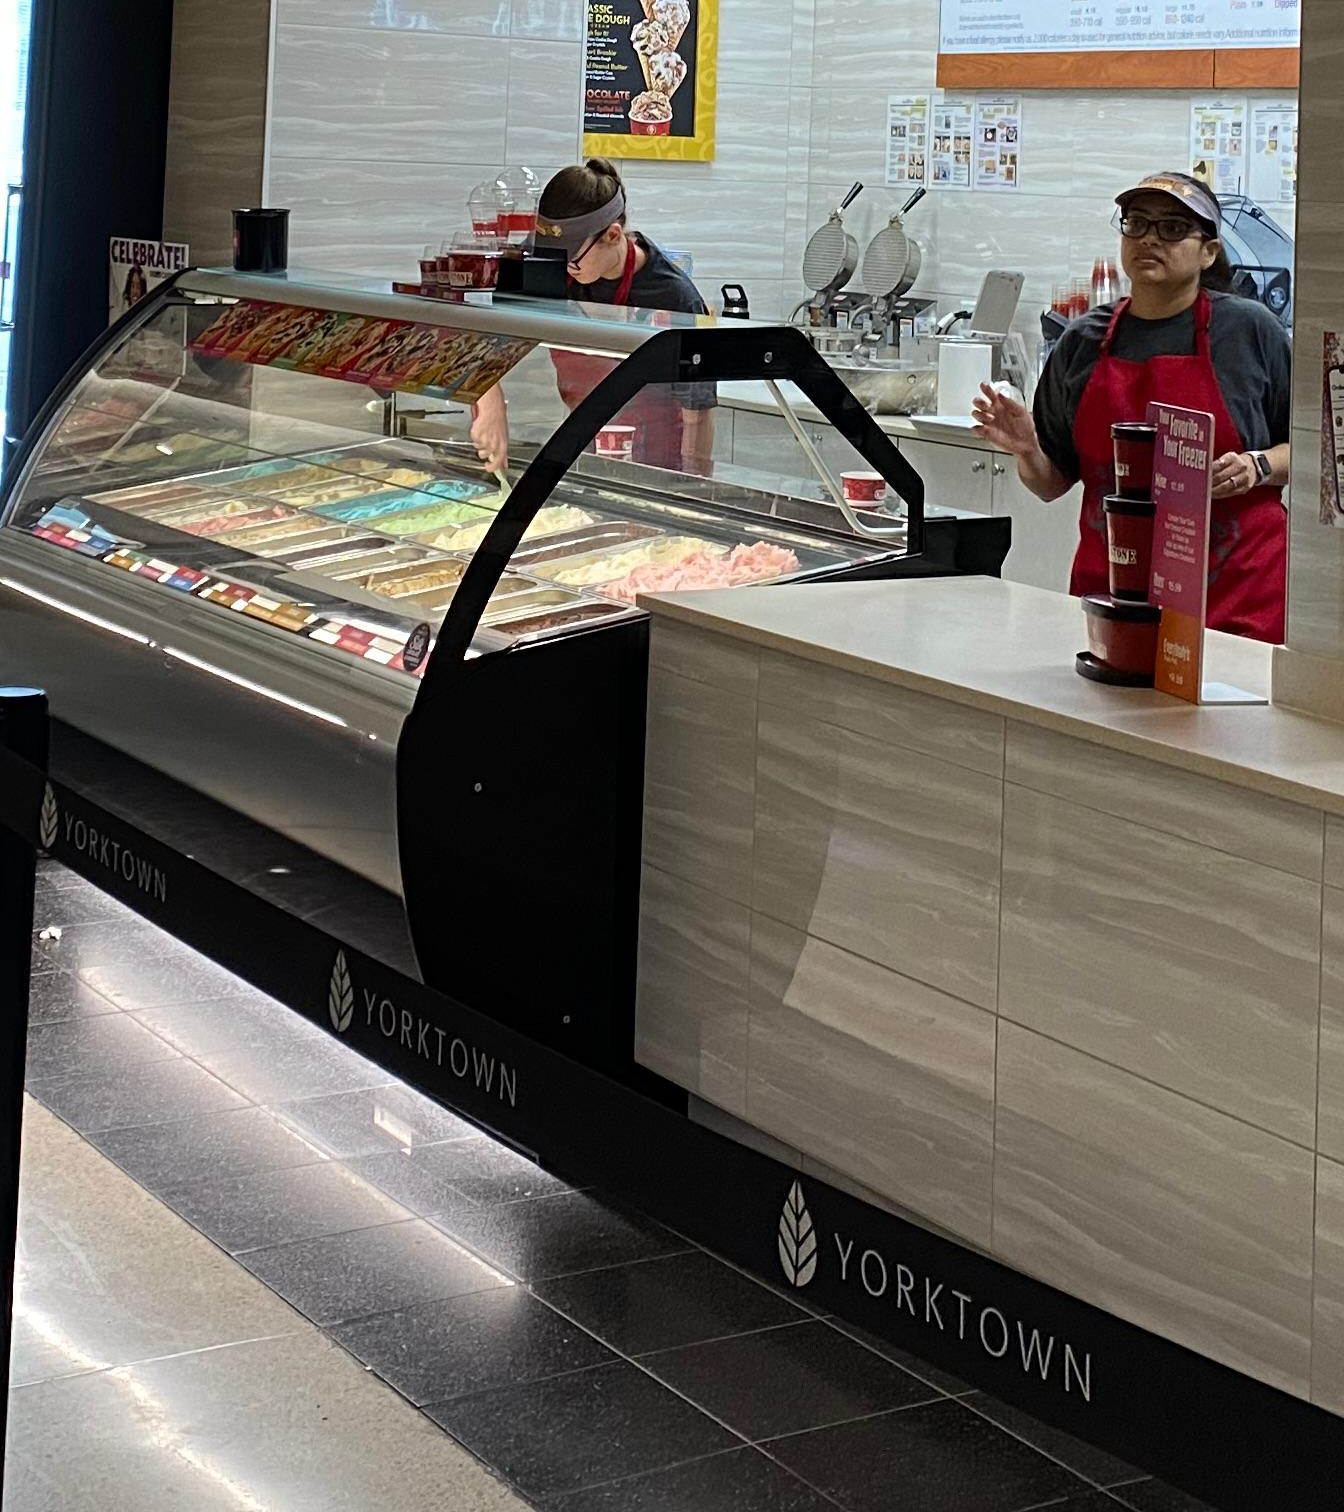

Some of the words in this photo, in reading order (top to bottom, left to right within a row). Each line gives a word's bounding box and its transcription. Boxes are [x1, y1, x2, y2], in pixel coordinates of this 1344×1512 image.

[588, 3, 614, 14] ASSIC
[596, 14, 631, 25] DOUGH
[586, 89, 631, 100] OCOLATE
[111, 239, 185, 271] CELEBRATE!
[1170, 414, 1199, 441] Favorite
[1164, 434, 1178, 459] Your
[1179, 440, 1207, 471] Freezer
[63, 810, 168, 904] YORKTOWN
[363, 987, 518, 1109] YORKTOWN
[833, 1231, 1092, 1404] YORKTOWN
